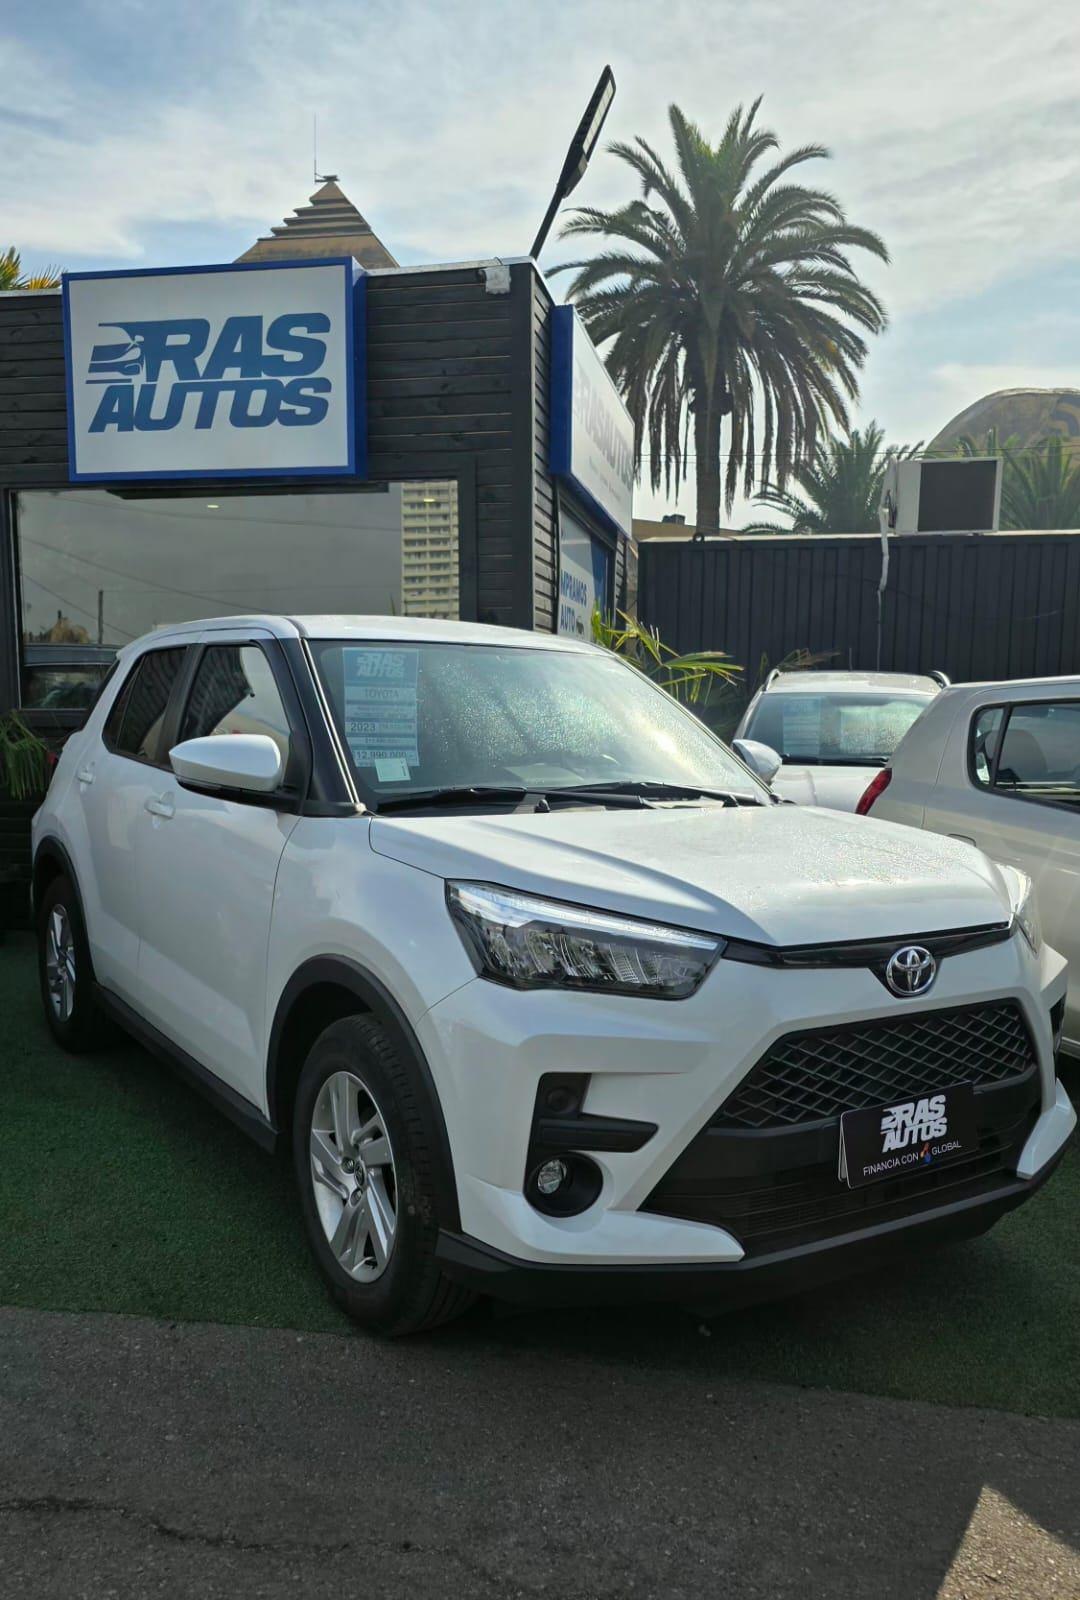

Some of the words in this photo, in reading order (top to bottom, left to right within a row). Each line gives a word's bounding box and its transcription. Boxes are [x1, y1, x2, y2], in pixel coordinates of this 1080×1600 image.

[128, 313, 331, 382] RAS
[88, 377, 332, 433] AUTOS
[364, 689, 400, 699] TOYOTA
[350, 722, 376, 732] 2023
[887, 1094, 947, 1130] RAS
[882, 1117, 948, 1153] AUTOS
[863, 1159, 901, 1176] FINANCIA
[901, 1152, 919, 1164] CON
[931, 1140, 962, 1156] GLOBAL
